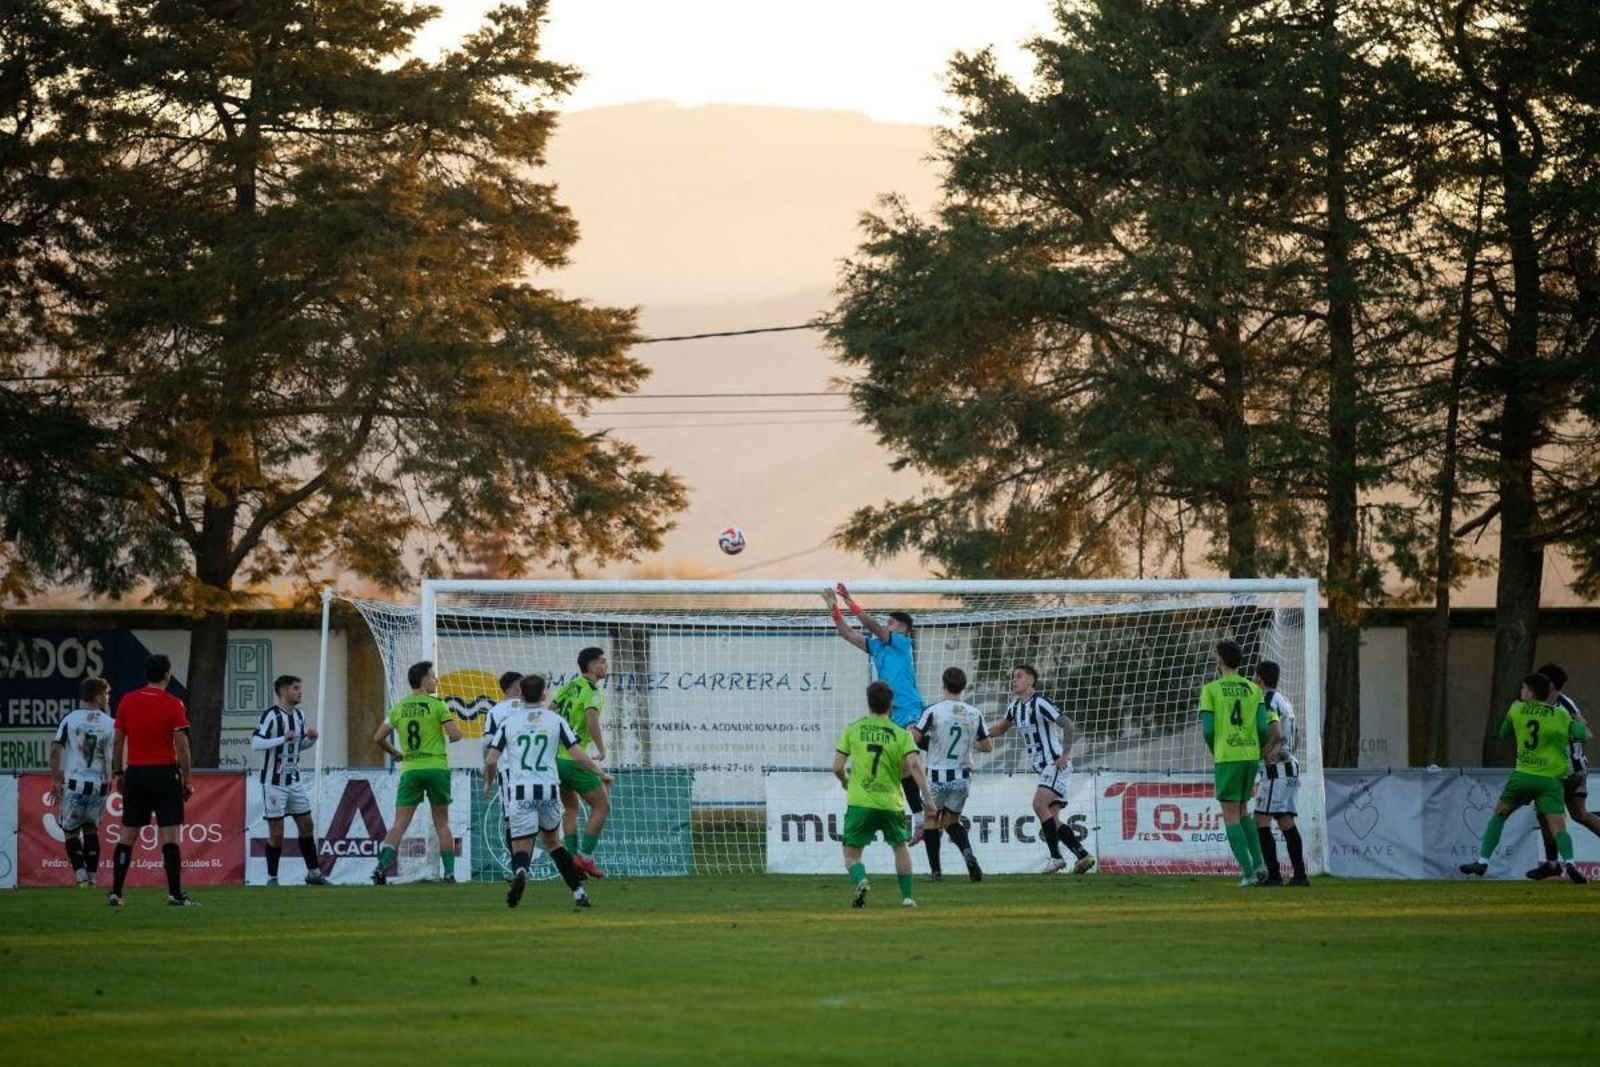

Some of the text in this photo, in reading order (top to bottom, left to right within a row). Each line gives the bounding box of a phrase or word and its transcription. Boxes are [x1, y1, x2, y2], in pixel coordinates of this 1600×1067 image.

[677, 671, 790, 691] CARRERA
[1230, 699, 1243, 727] 4
[408, 720, 421, 750] 8
[947, 726, 961, 760] 2
[1525, 720, 1540, 750] 3
[85, 733, 98, 768] 7
[517, 735, 550, 771] 22
[867, 744, 883, 777] 7
[1331, 844, 1395, 855] ATRAVE
